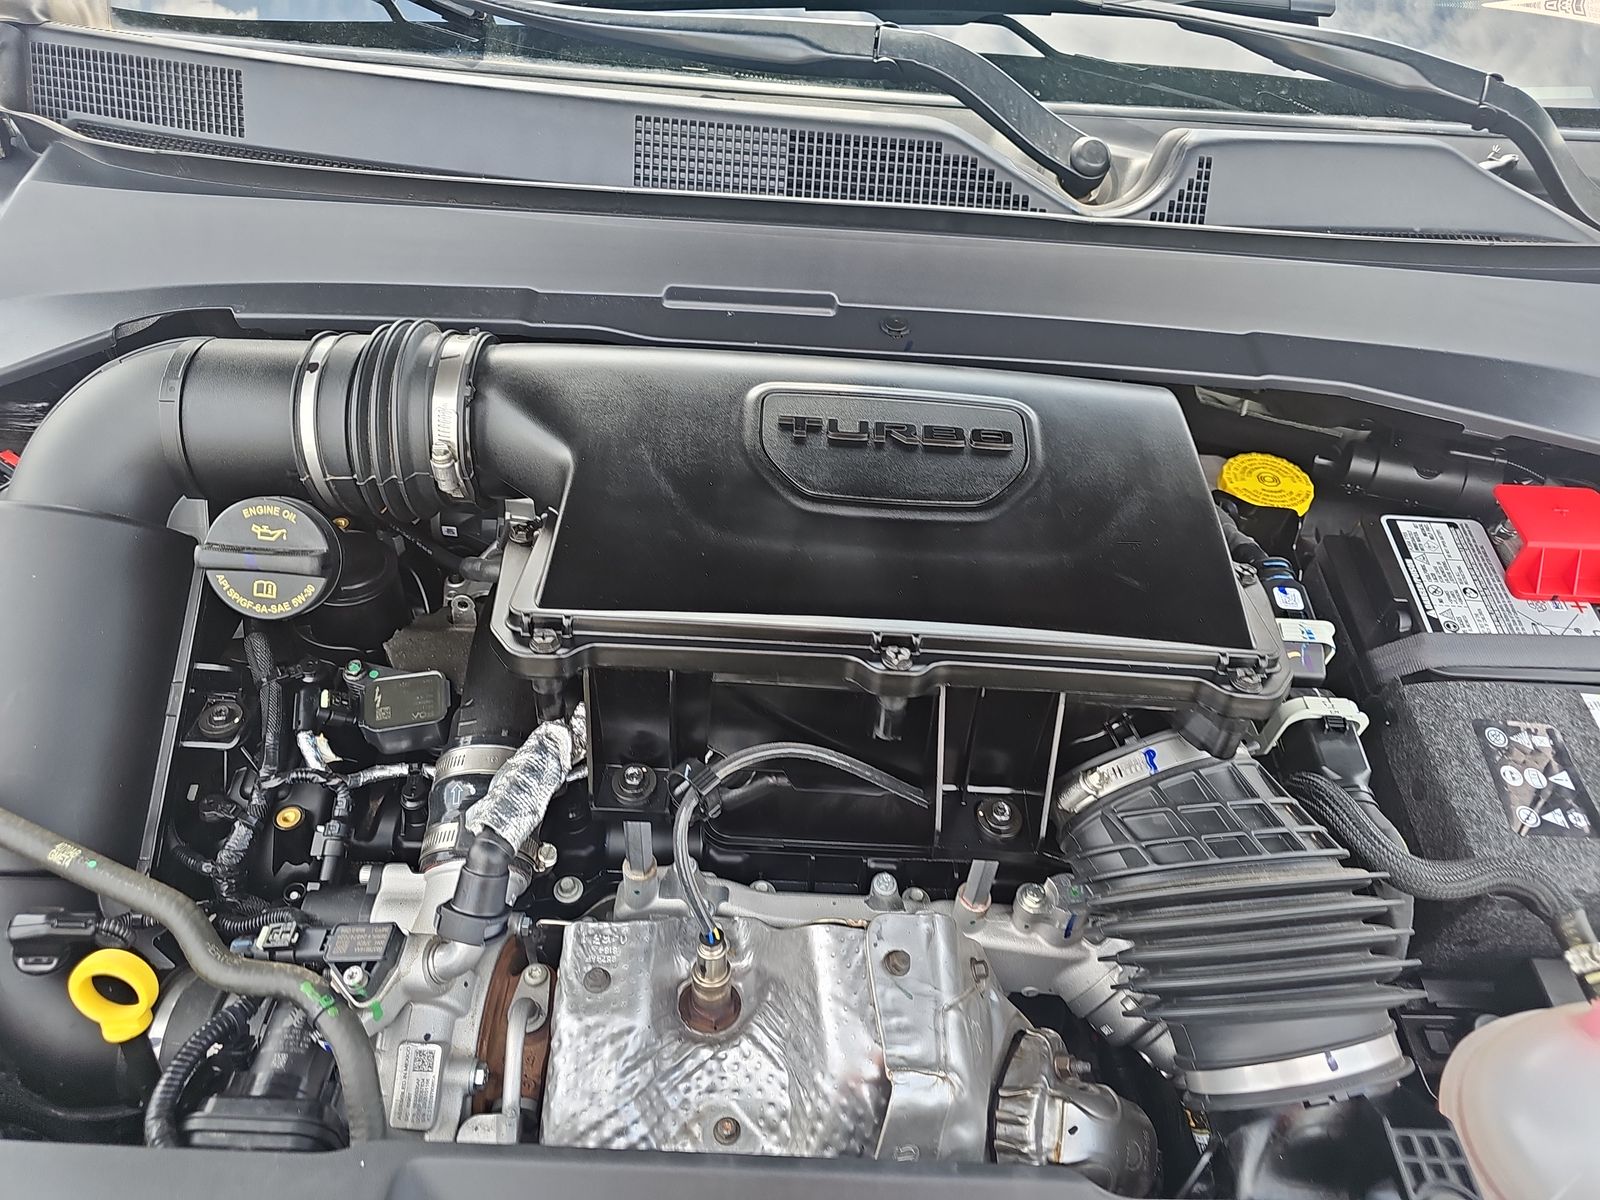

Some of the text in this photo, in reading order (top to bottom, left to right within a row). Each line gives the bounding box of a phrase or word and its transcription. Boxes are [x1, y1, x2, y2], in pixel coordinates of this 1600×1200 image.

[778, 415, 1014, 452] TURBO
[242, 505, 297, 523] ENGINE OIL
[216, 574, 228, 591] API
[291, 584, 316, 608] 5W-30
